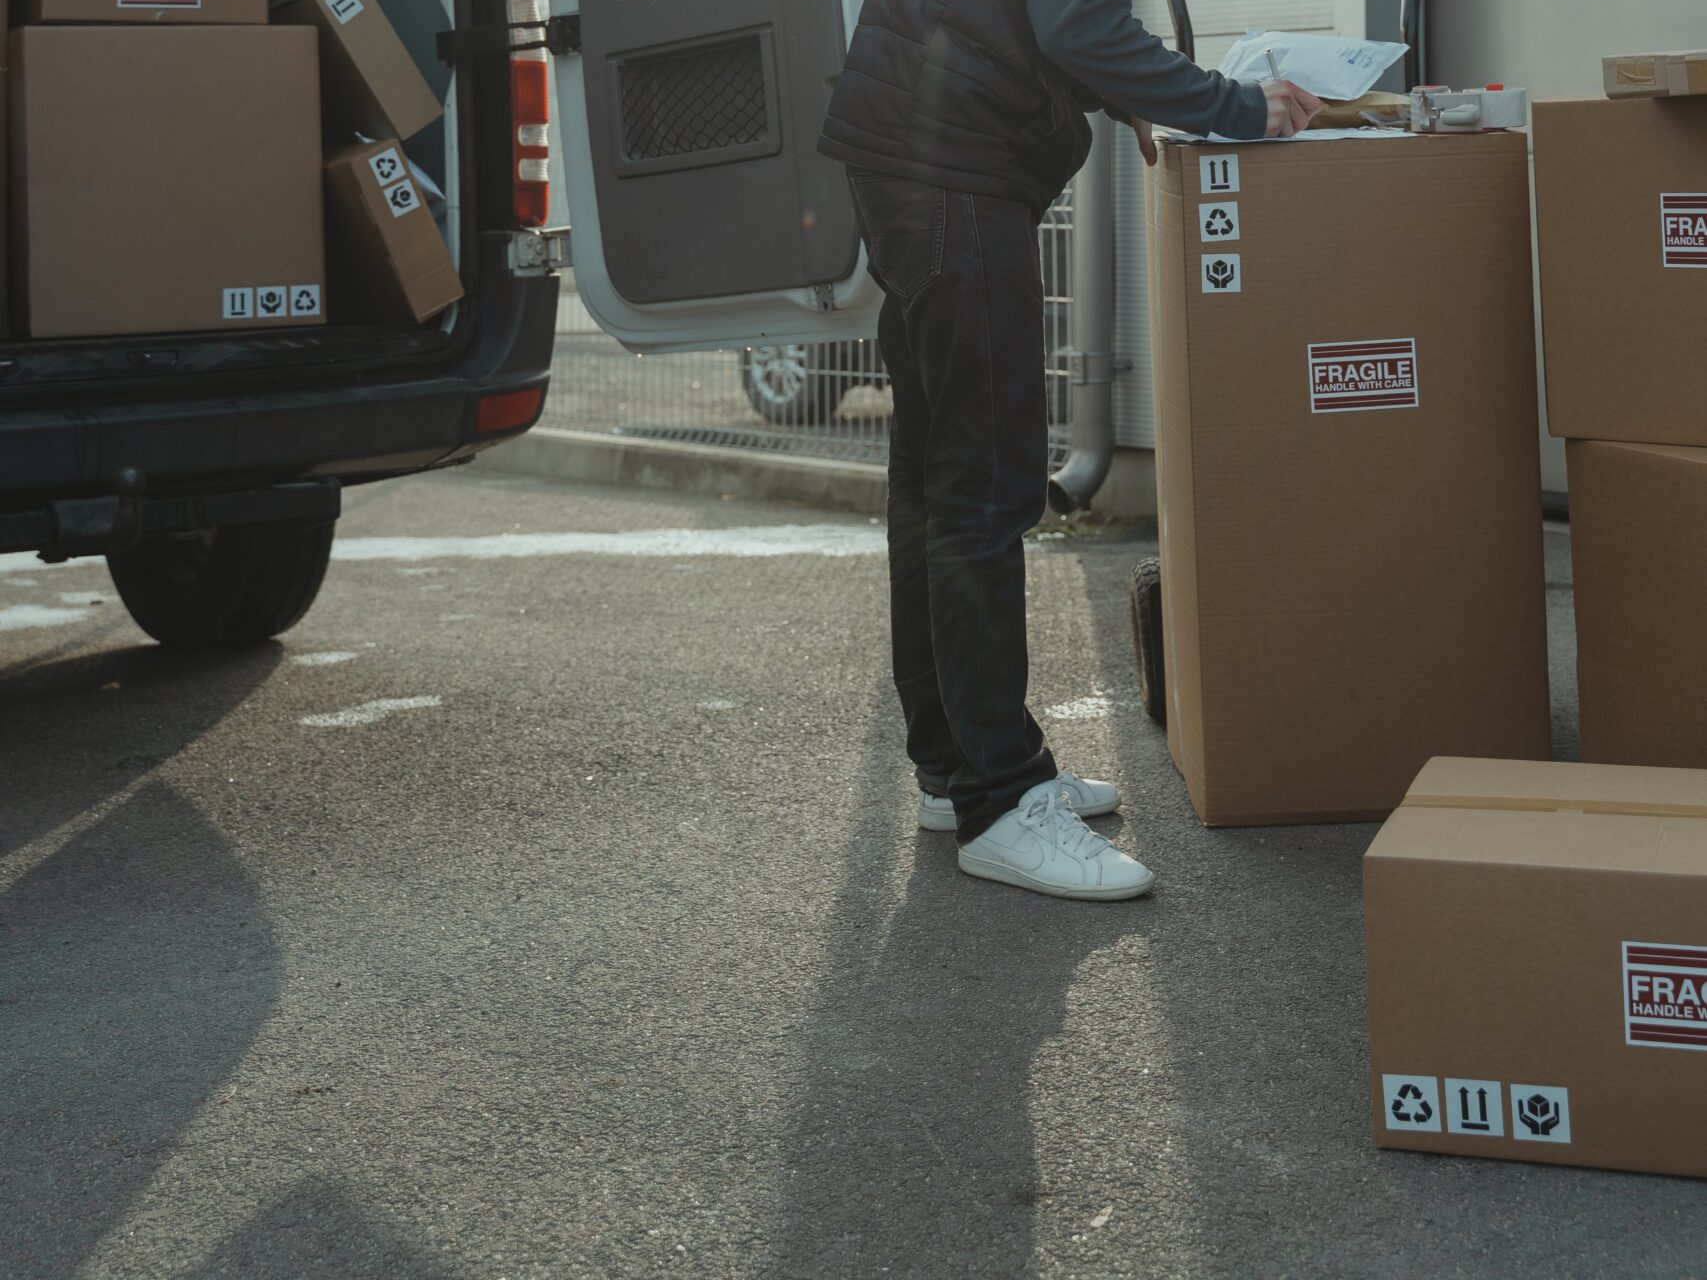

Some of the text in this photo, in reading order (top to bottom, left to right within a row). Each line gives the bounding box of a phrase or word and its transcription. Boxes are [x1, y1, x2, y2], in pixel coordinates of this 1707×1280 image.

[1667, 236, 1705, 246] HANDLE
[1314, 360, 1412, 384] FRAGILE
[1315, 378, 1412, 393] HANDLE WITH CARE
[1631, 974, 1707, 1006] FRA
[1633, 1002, 1694, 1019] HANDLE
